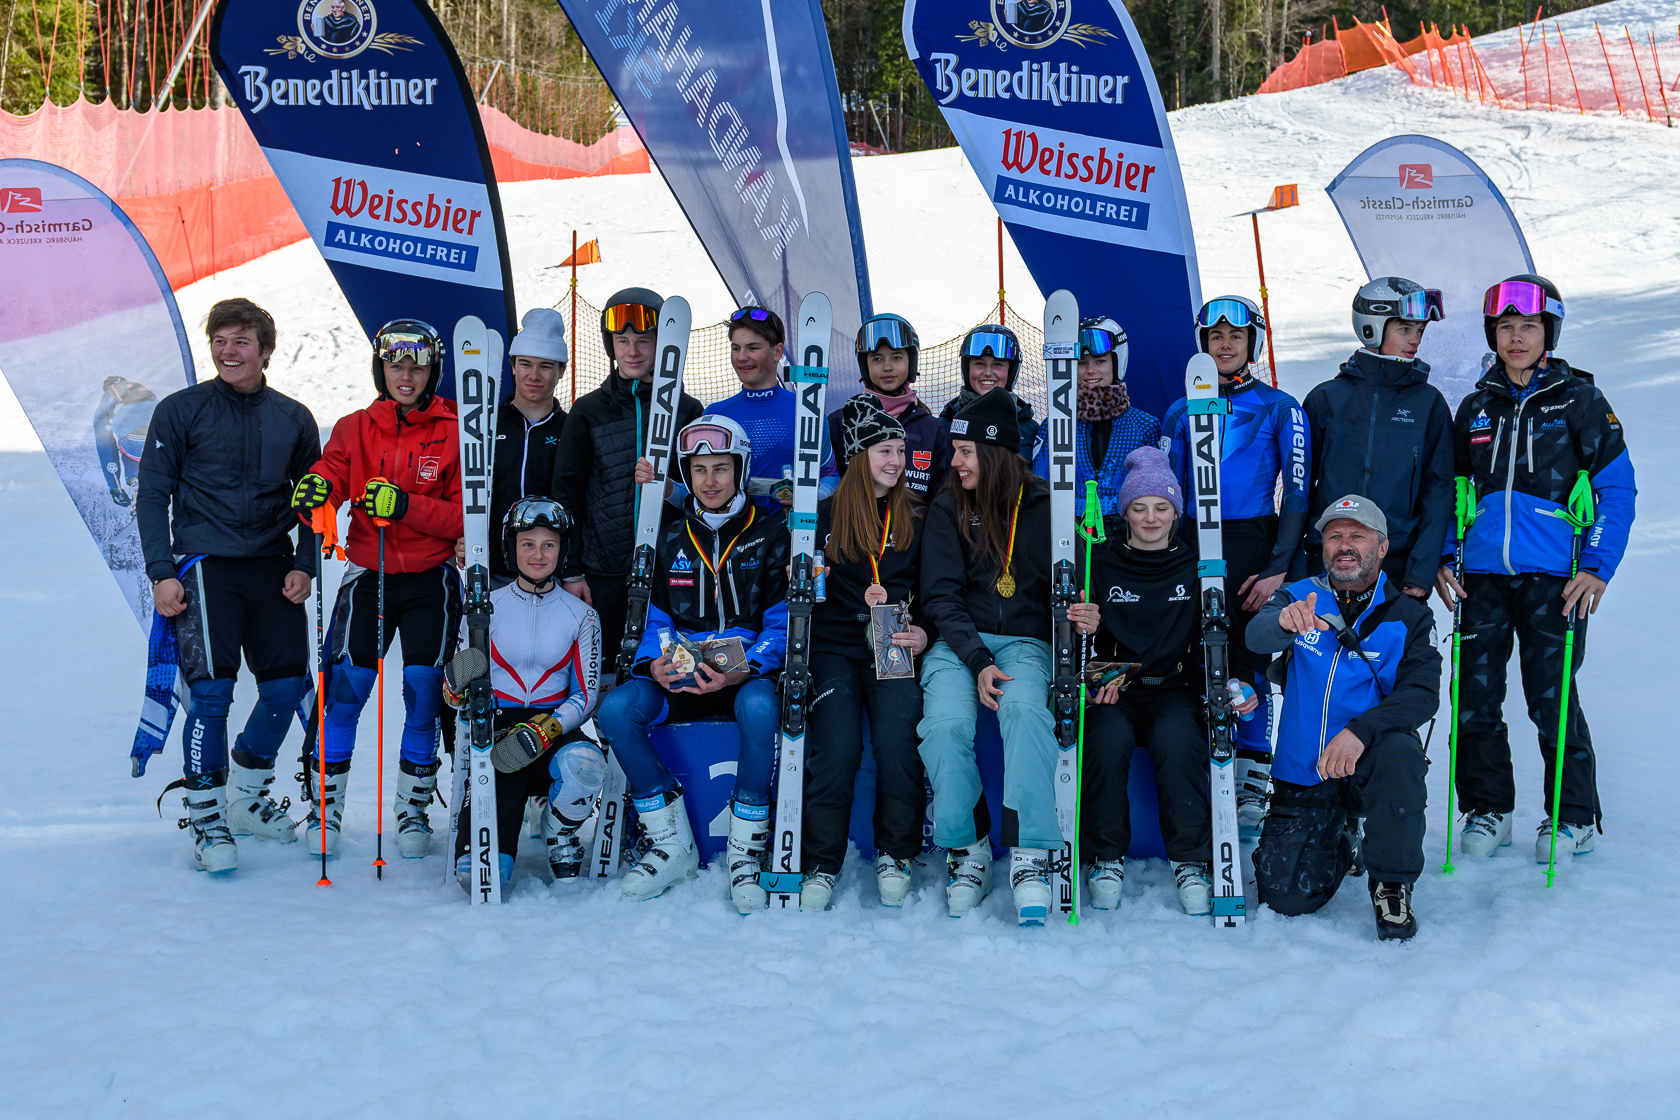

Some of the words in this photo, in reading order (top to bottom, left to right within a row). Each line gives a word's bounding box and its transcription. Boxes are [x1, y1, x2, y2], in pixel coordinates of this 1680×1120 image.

[237, 64, 439, 114] Benediktiner
[930, 52, 1130, 107] Benediktiner
[1001, 127, 1156, 193] Weissbier
[329, 175, 482, 236] Weissbier
[1003, 184, 1138, 223] ALKOHOLFREI
[334, 230, 468, 266] ALKOHOLFREI
[649, 344, 682, 482] HEAD
[797, 344, 824, 487] HEAD
[463, 368, 487, 515] HEAD
[1290, 407, 1306, 492] ziener
[904, 469, 931, 481] WÜRT
[910, 482, 929, 492] TERRE
[1196, 414, 1220, 529] HEAD
[671, 560, 692, 570] ASV
[587, 638, 600, 691] Schöffel
[1460, 633, 1478, 641] ener
[190, 718, 206, 774] ziener
[737, 806, 766, 815] HEAD
[480, 827, 491, 904] HEAD
[597, 801, 618, 878] HEAD
[778, 830, 796, 908] HAD
